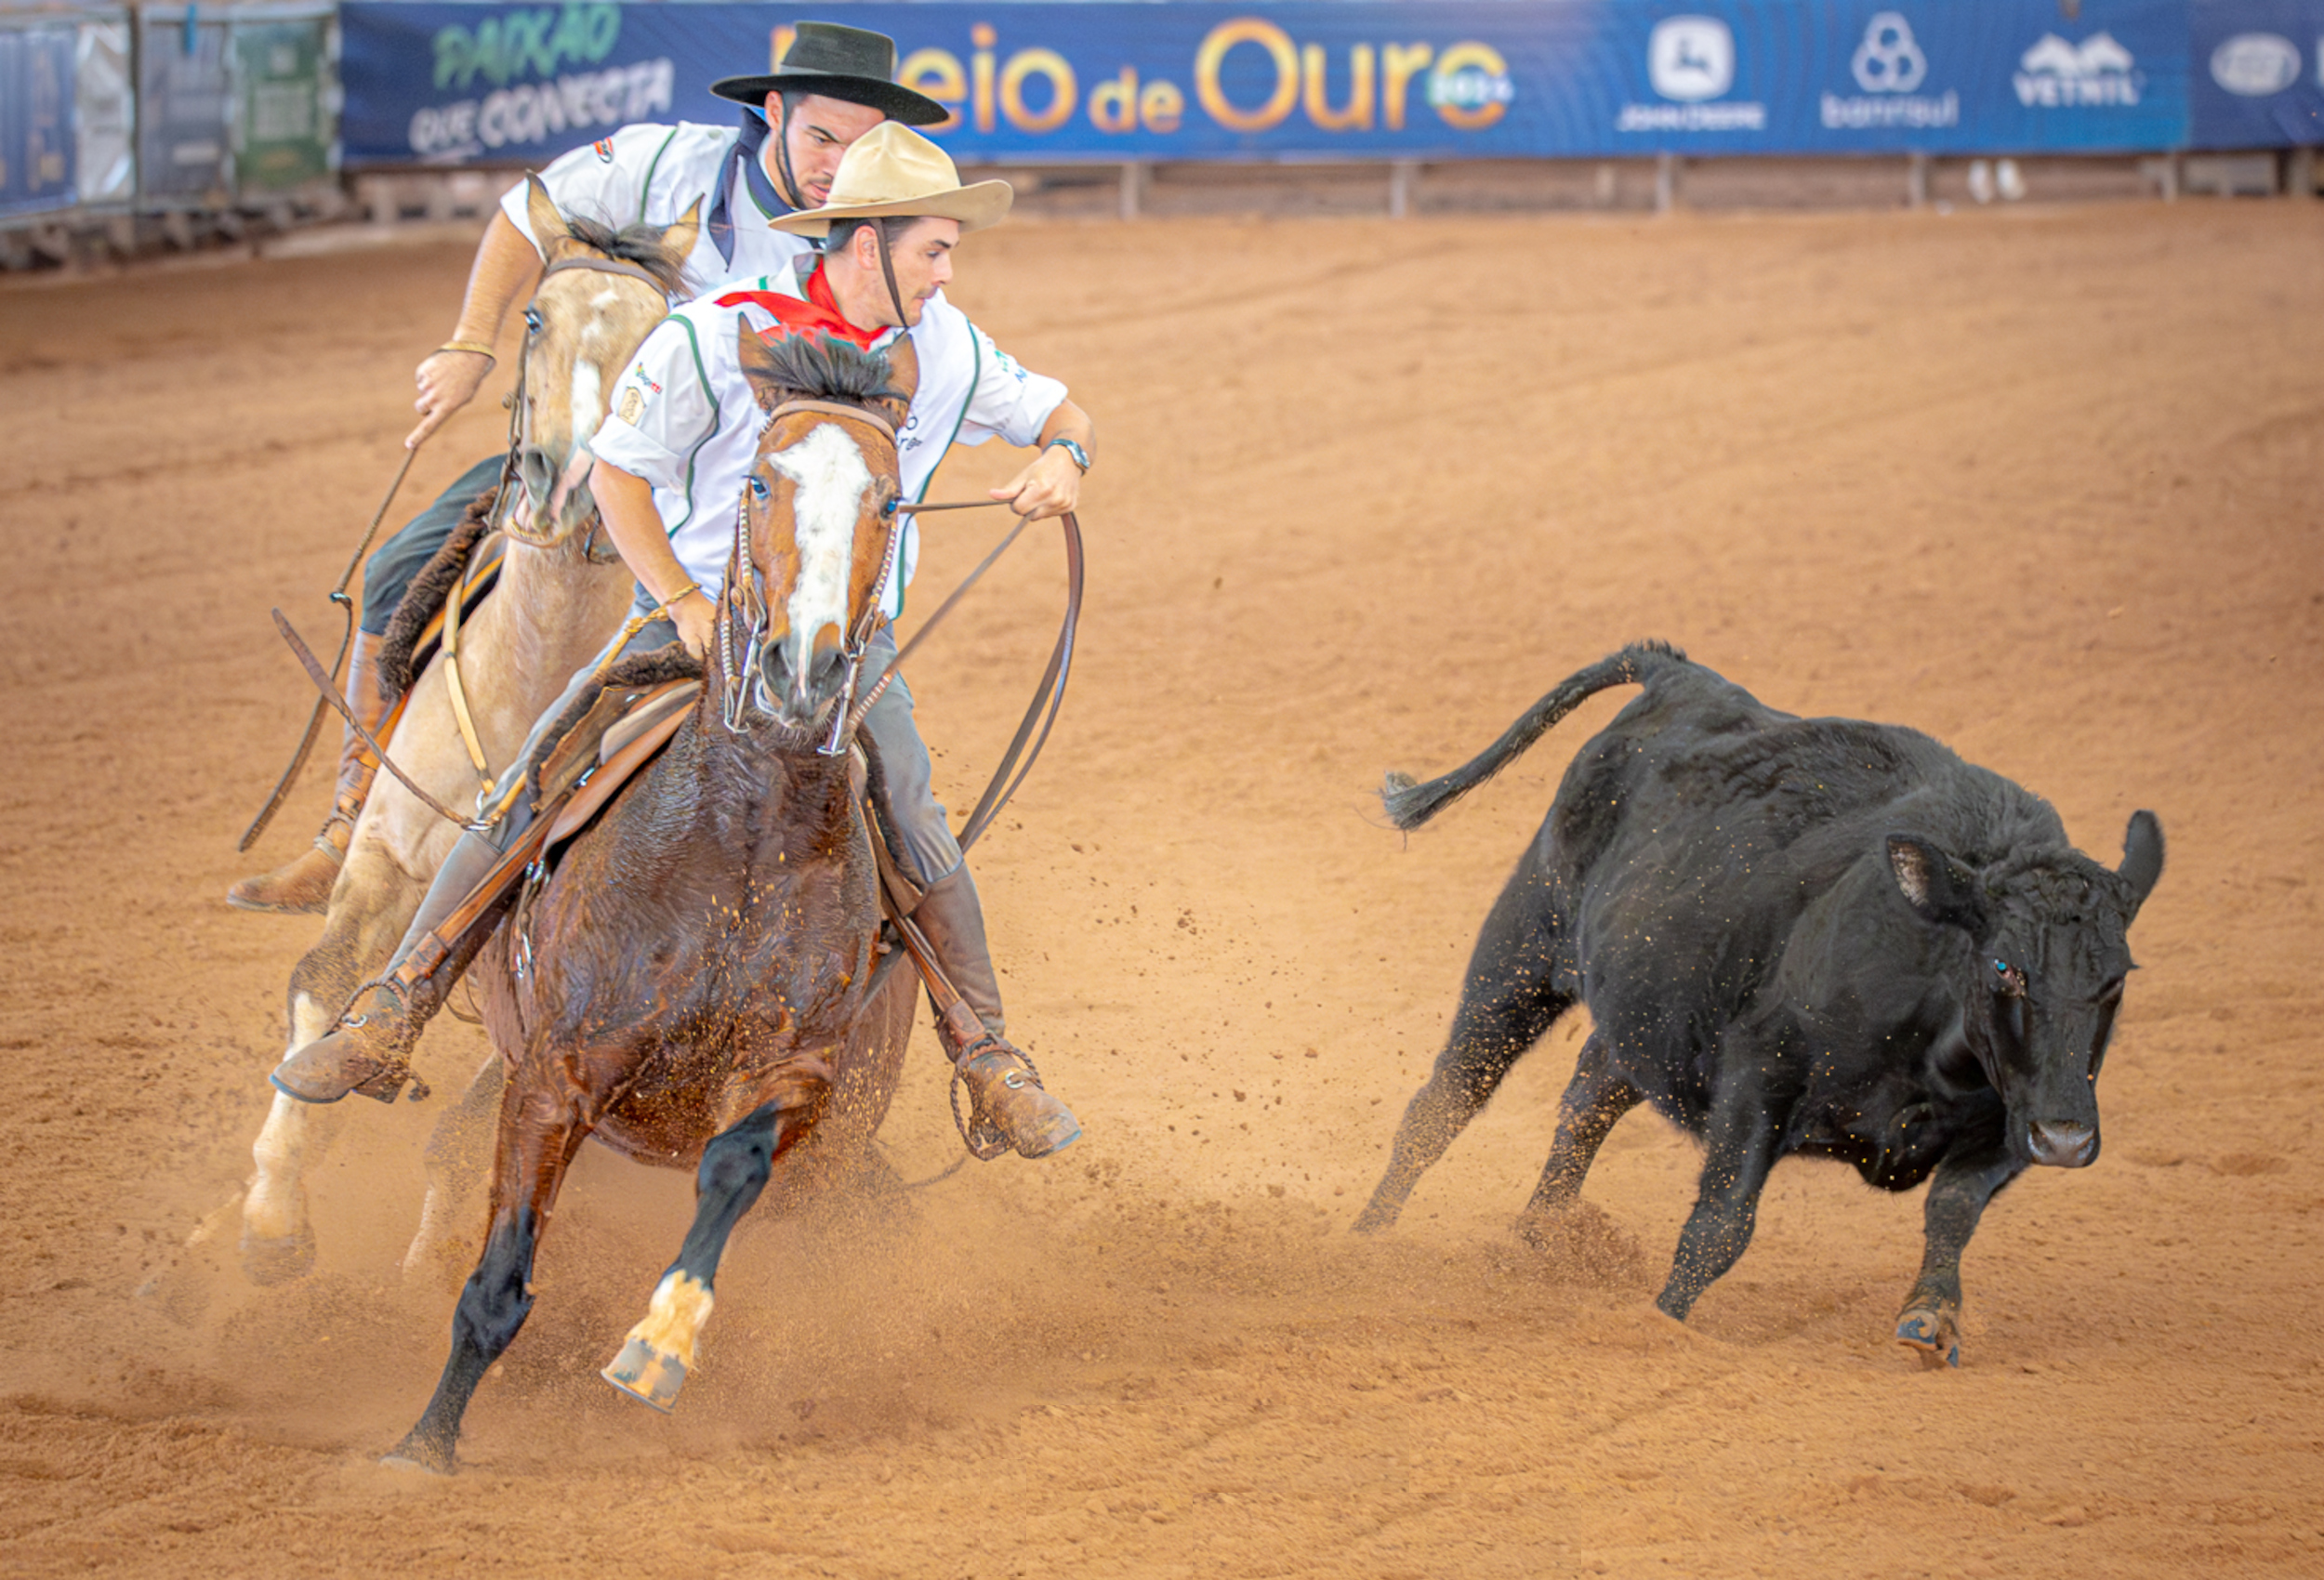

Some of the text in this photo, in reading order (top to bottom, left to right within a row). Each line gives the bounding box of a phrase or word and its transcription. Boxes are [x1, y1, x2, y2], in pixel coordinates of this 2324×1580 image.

[477, 56, 674, 148] CONECTA
[1087, 65, 1183, 134] de
[1194, 19, 1506, 133] Ouro
